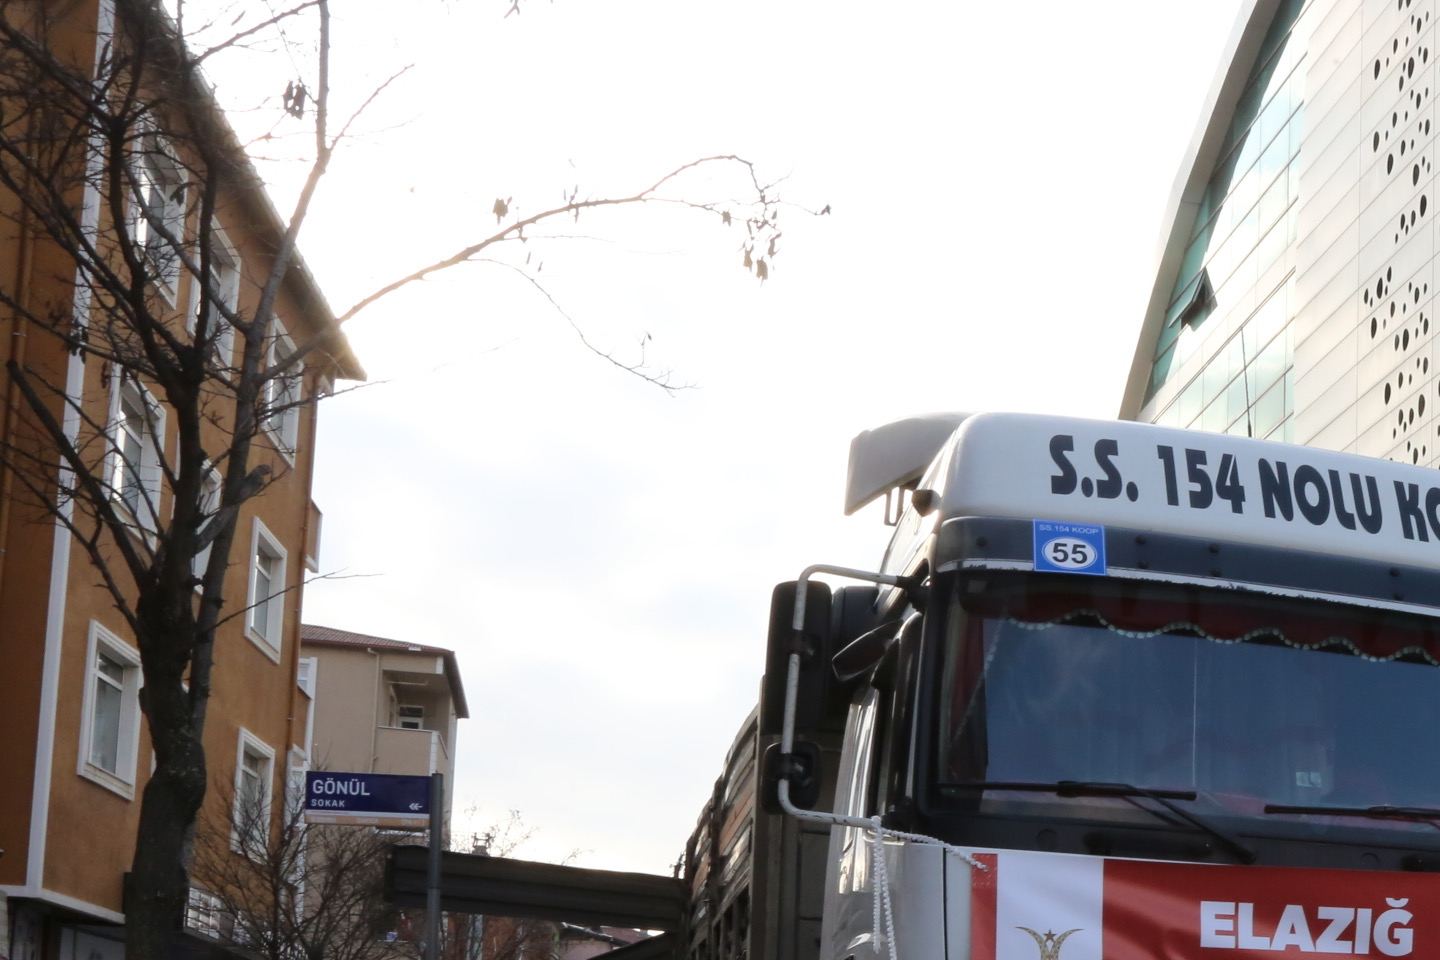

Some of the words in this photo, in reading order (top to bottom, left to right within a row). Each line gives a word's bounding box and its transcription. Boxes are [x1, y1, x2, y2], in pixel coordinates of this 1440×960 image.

[1049, 434, 1138, 502] S.S.
[1157, 445, 1245, 514] 154
[1259, 458, 1382, 534] NOLU
[1052, 542, 1088, 564] 55
[312, 777, 370, 796] GÖNÜL
[310, 799, 345, 808] SOKAK
[1200, 897, 1414, 957] ELAZIĞ
